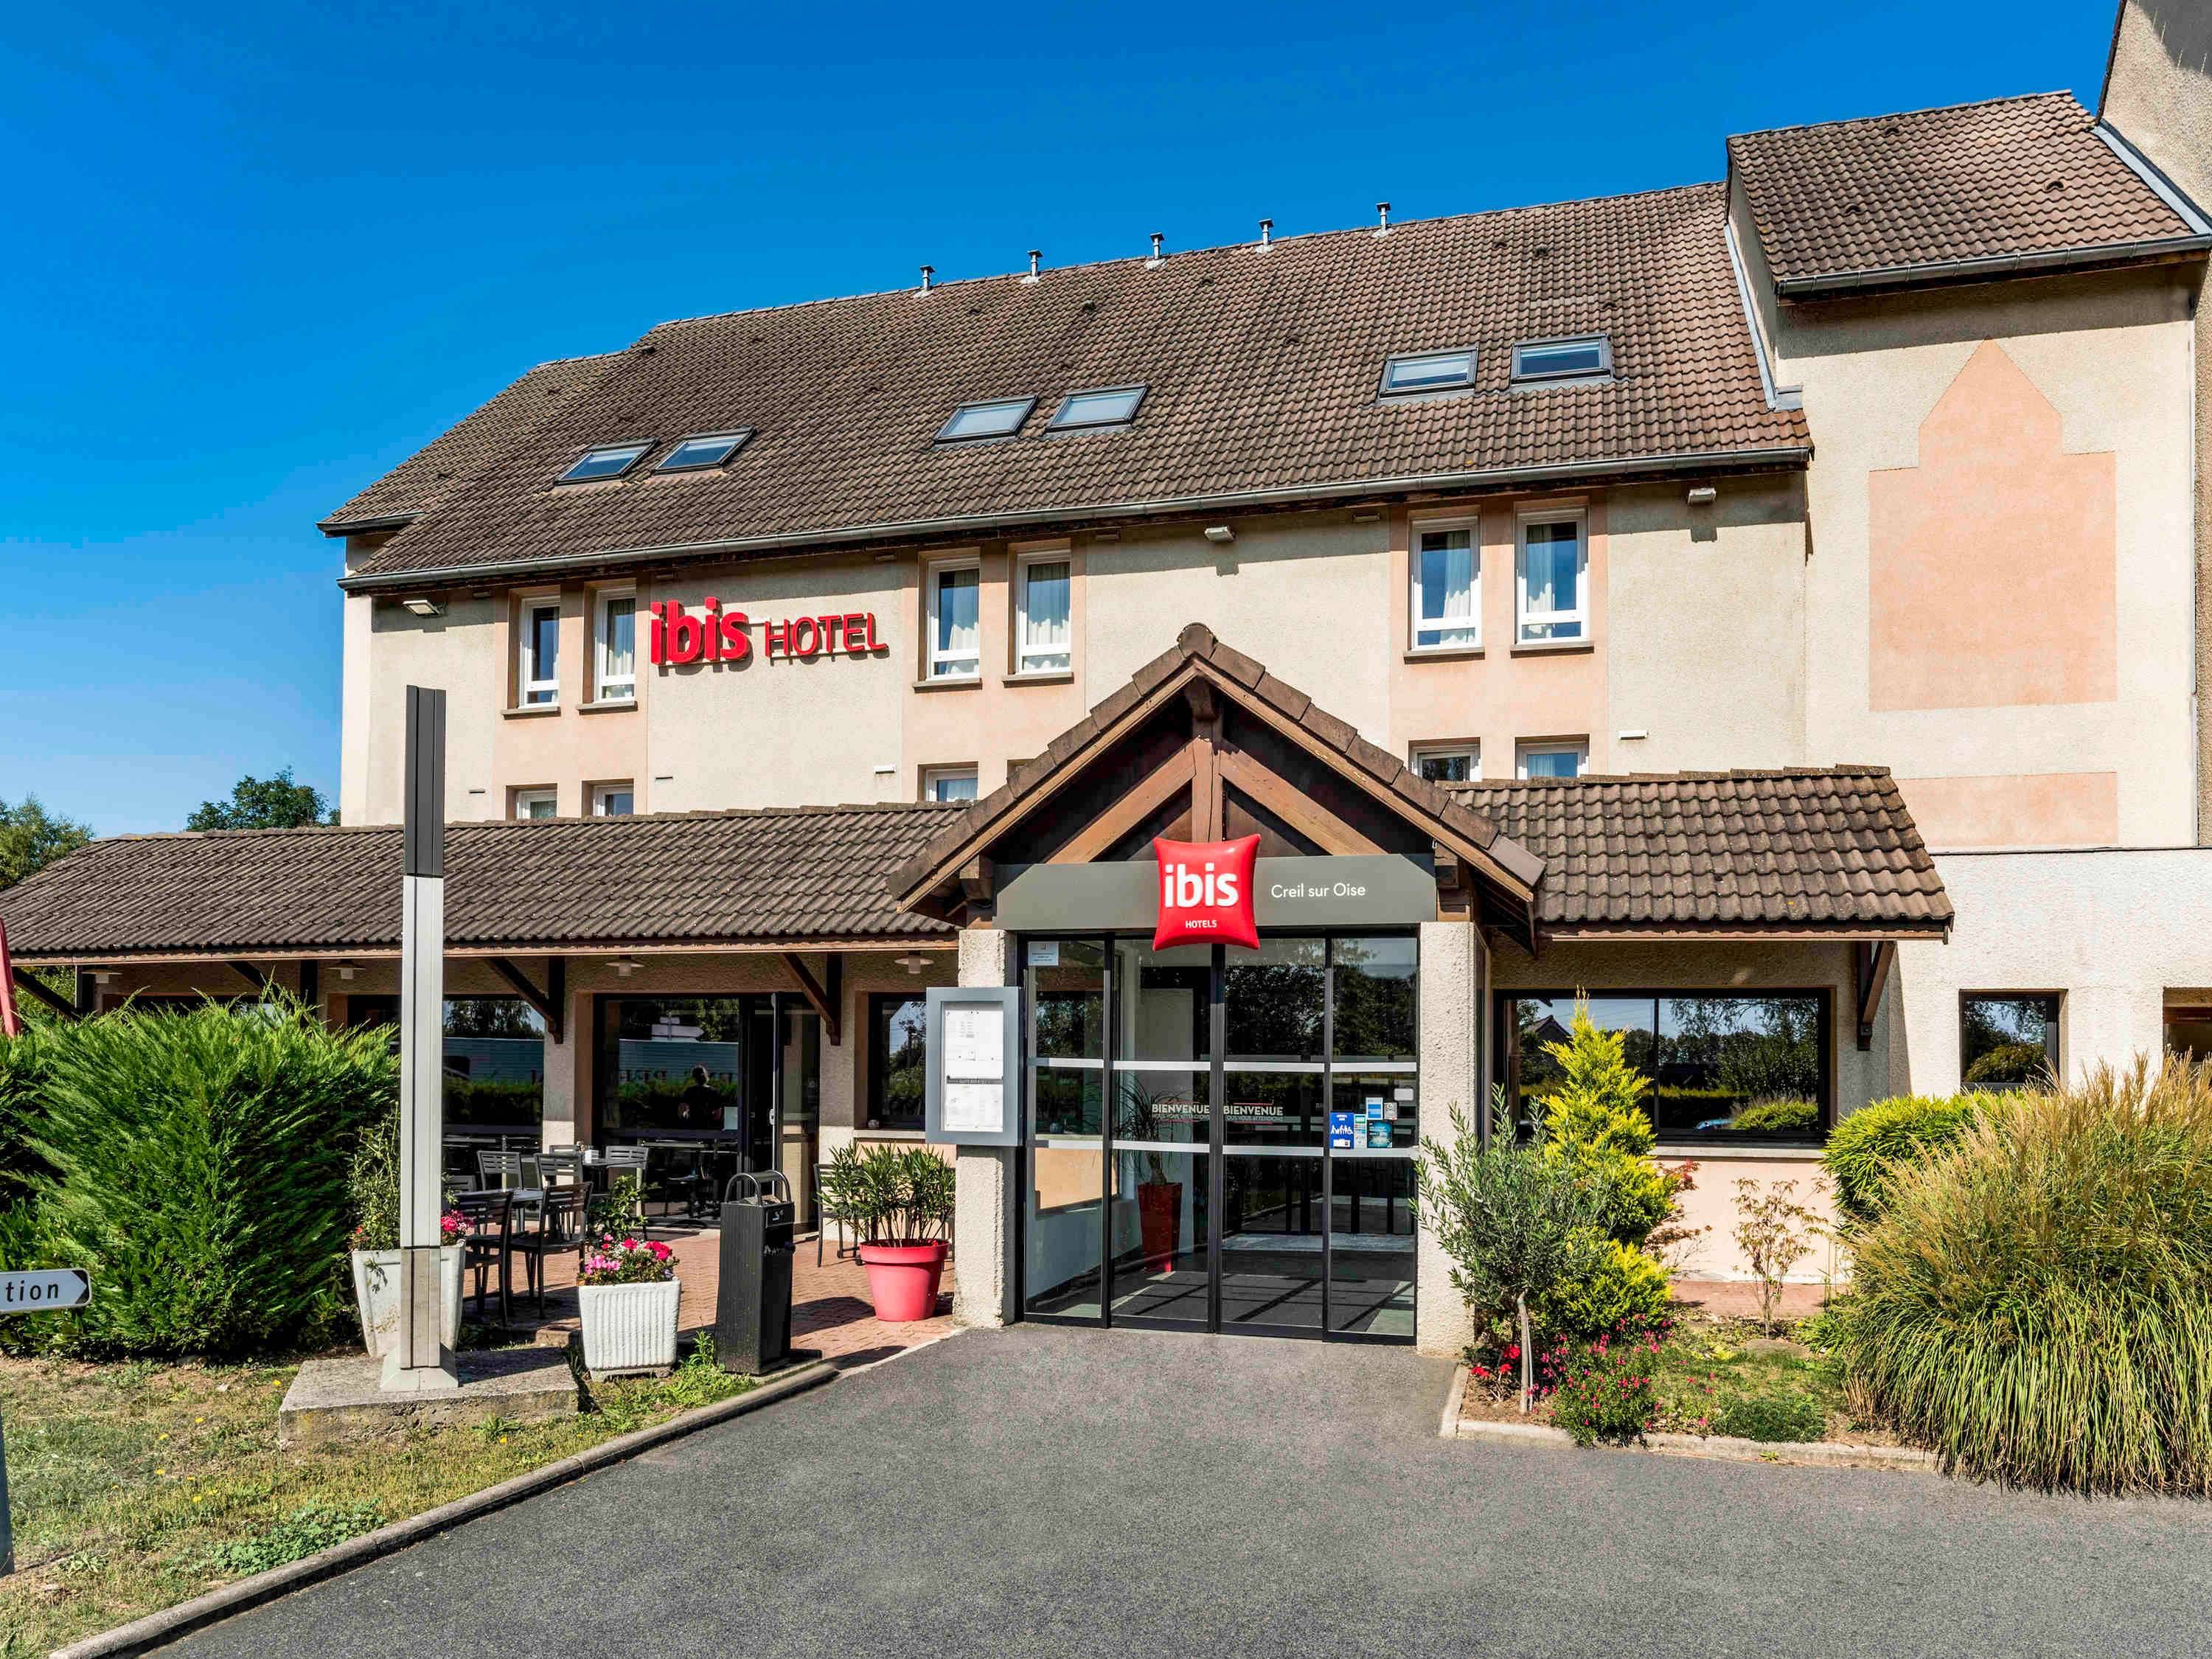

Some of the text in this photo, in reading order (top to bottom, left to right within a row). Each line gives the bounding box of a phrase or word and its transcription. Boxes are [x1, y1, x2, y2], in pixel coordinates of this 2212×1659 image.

[650, 597, 889, 664] ibis HOTEL
[1164, 863, 1239, 908] ibis
[1270, 880, 1366, 899] Creil sur Oise
[1185, 919, 1217, 929] HOTELS
[1152, 1104, 1209, 1114] BIENVENUE
[1223, 1105, 1283, 1116] BIENVENUE
[5, 1280, 59, 1302] tion
